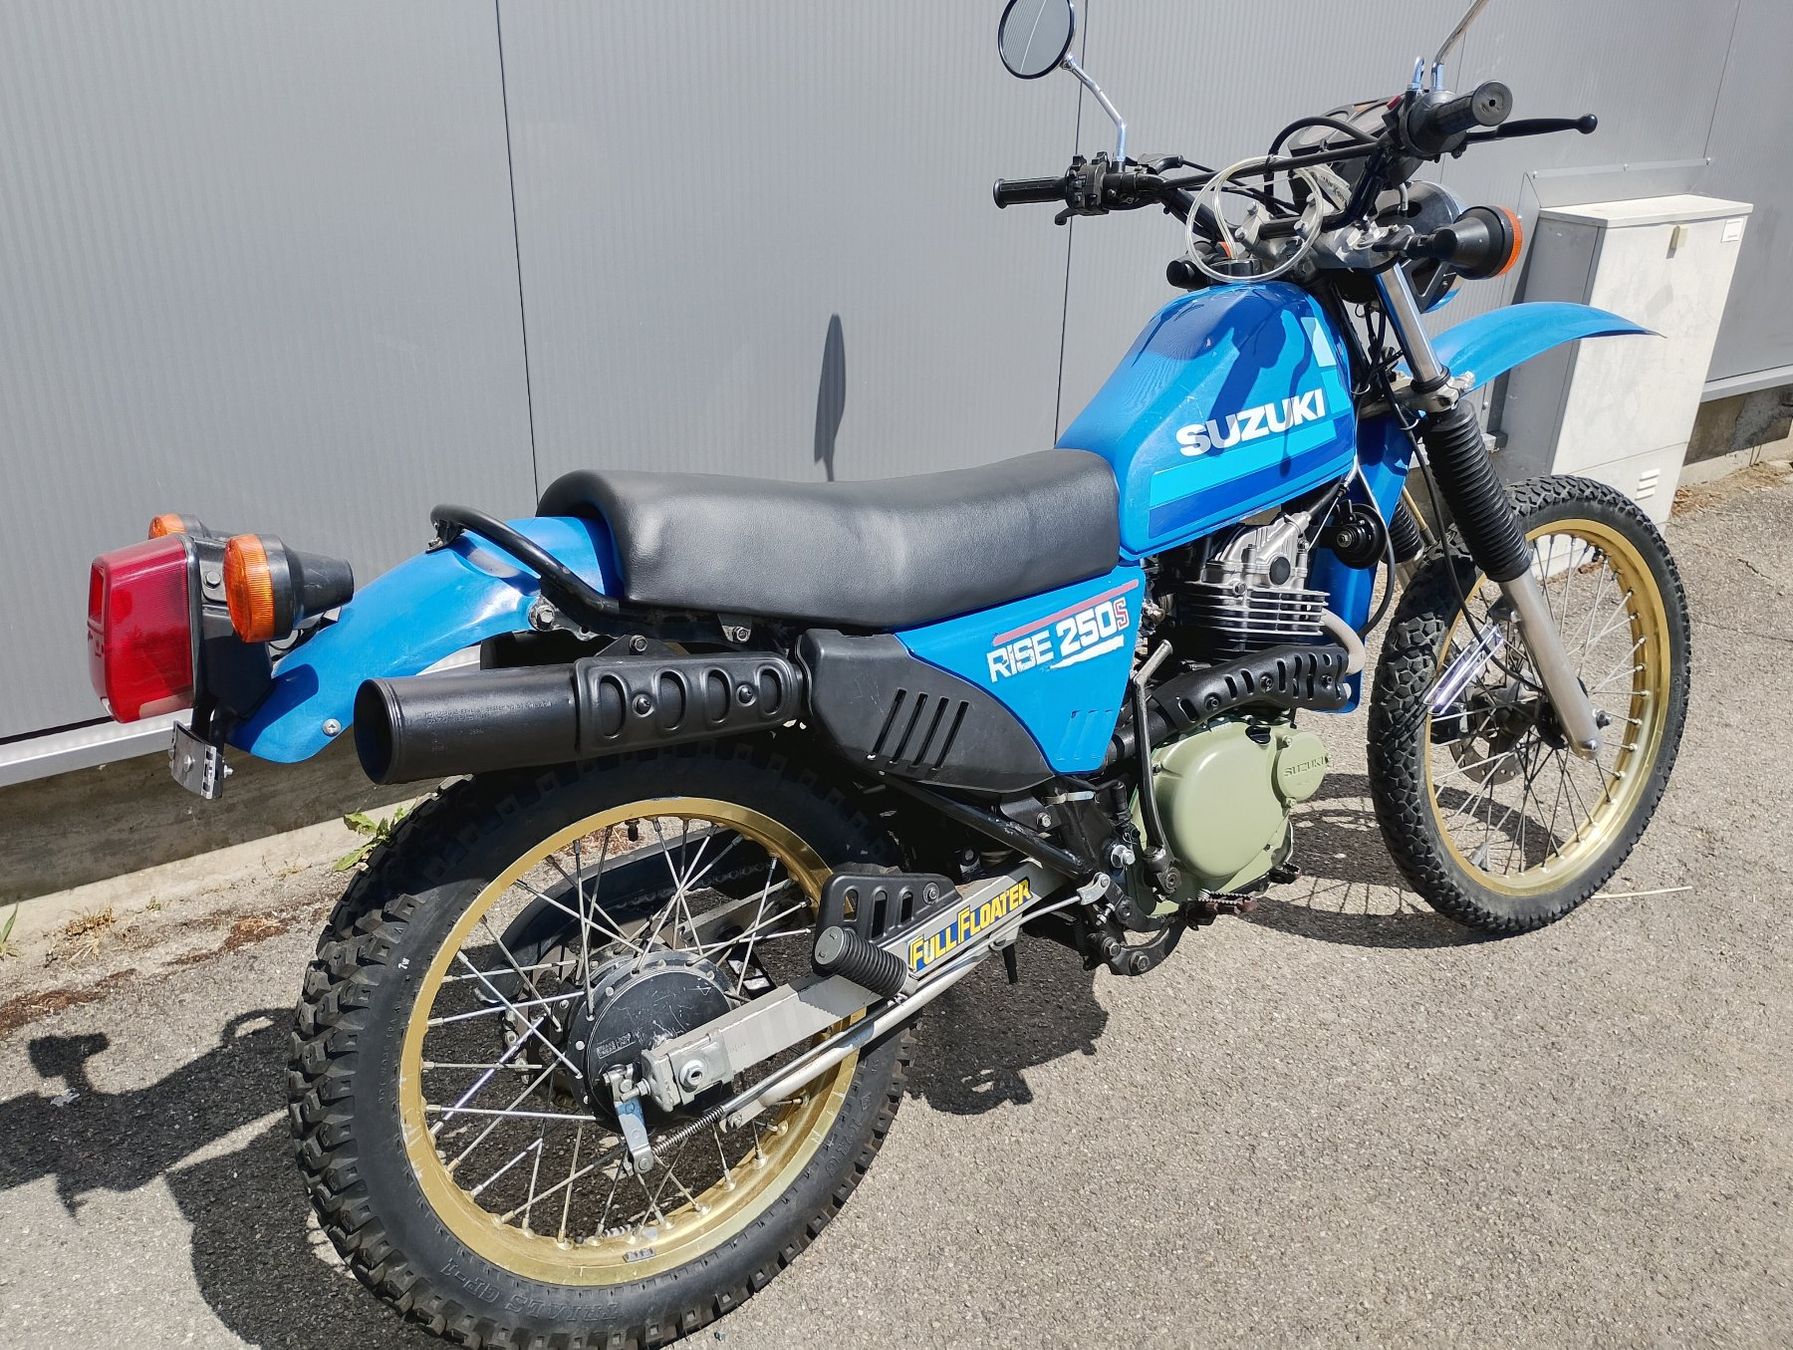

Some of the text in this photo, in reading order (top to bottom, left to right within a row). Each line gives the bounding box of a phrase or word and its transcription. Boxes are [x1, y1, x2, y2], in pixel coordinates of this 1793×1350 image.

[1175, 388, 1325, 457] SUZUKI
[986, 629, 1055, 683] RISE
[1283, 755, 1324, 777] SUZUKI
[909, 877, 1033, 972] FULL FLOATER
